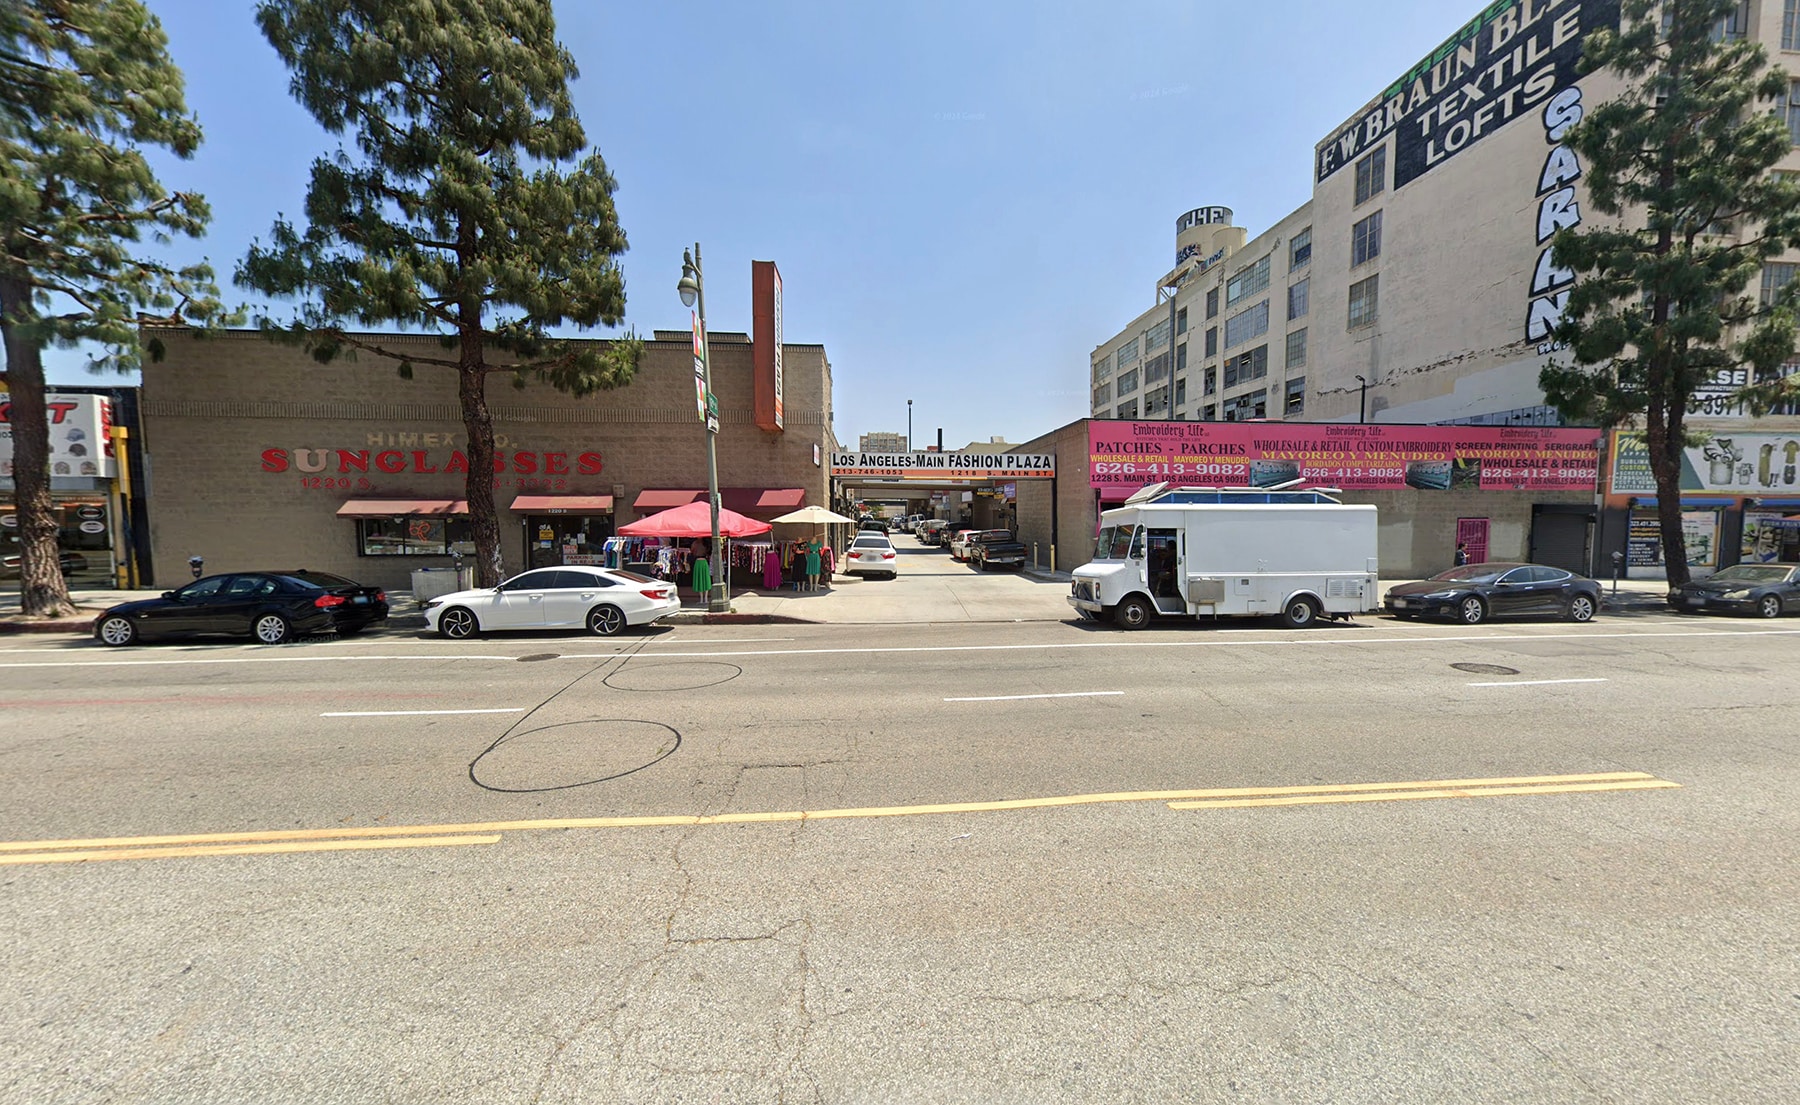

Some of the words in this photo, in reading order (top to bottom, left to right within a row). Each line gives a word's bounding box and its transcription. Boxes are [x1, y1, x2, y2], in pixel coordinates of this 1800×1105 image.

[1416, 4, 1581, 137] TEXTILE
[1364, 35, 1479, 145] BRAUN
[1425, 63, 1556, 166] LOFTS
[1133, 424, 1184, 437] Embroidery
[1187, 424, 1204, 436] Life
[1326, 426, 1366, 437] Embroidery
[1369, 426, 1382, 436] Life
[366, 432, 457, 448] HIMEX
[1096, 442, 1162, 453] PATCHES
[1181, 443, 1246, 455] PARCHES
[1253, 440, 1309, 451] WHOLESALE
[1311, 440, 1318, 451] &
[1320, 441, 1352, 451] RETAIL
[1357, 441, 1394, 452] CUSTOM
[1395, 441, 1453, 453] EMBROIDERY
[833, 453, 855, 466] LOS
[860, 454, 944, 467] ANGELES-MAIN
[949, 455, 1002, 467] FASHION
[1007, 456, 1051, 468] PLAZA
[1090, 454, 1136, 462] WHOLESALE
[1145, 455, 1169, 463] RETAIL
[1173, 456, 1208, 464] MAYOREO
[1215, 456, 1250, 464] MENUDEO
[1262, 451, 1345, 459] MAYOREO
[1364, 452, 1446, 460] MENUDEO
[1454, 450, 1520, 458] MAYOREO
[1523, 450, 1530, 458] Y
[1535, 451, 1598, 459] MENUDEO
[1095, 462, 1246, 475] 626-413-9082
[1483, 459, 1548, 468] WHOLESALE
[1551, 460, 1559, 468] &
[1562, 460, 1597, 468] RETAIL
[1302, 467, 1403, 477] 626-413-9082
[1482, 469, 1597, 478] 626-413-9082
[301, 477, 351, 489] 1220
[1091, 474, 1112, 482] 1228
[1114, 474, 1122, 482] S.
[1178, 475, 1212, 483] ANGELES
